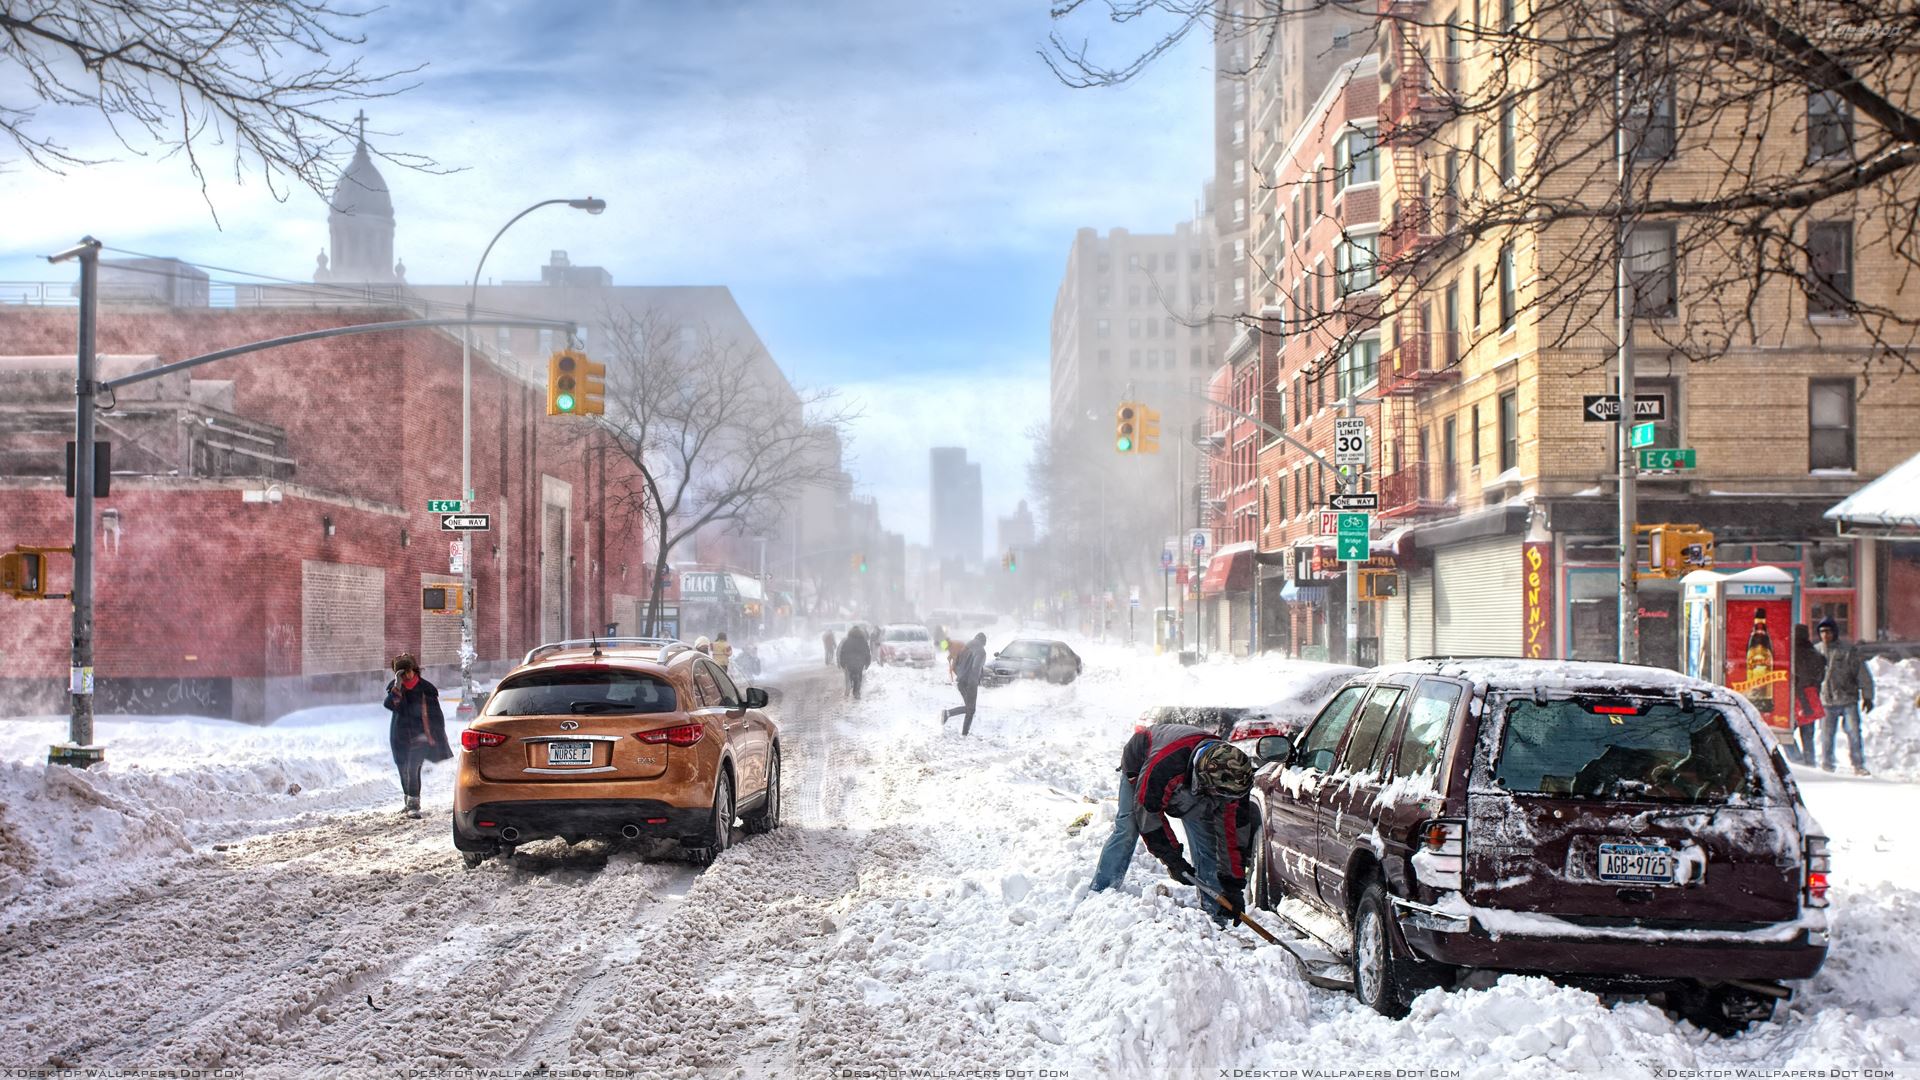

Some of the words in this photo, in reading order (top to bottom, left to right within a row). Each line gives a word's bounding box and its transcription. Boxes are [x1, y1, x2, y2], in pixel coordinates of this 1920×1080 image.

[1595, 403, 1620, 414] ONE
[1336, 420, 1364, 428] SPEED
[1338, 436, 1362, 452] 30
[1646, 452, 1657, 467] E
[1661, 452, 1672, 467] 6
[432, 501, 439, 511] E
[441, 501, 448, 511] 6
[1337, 498, 1350, 506] ONE
[1357, 498, 1372, 506] WAY
[1743, 585, 1776, 595] TITAN
[554, 749, 577, 760] NURSE
[581, 749, 587, 759] P
